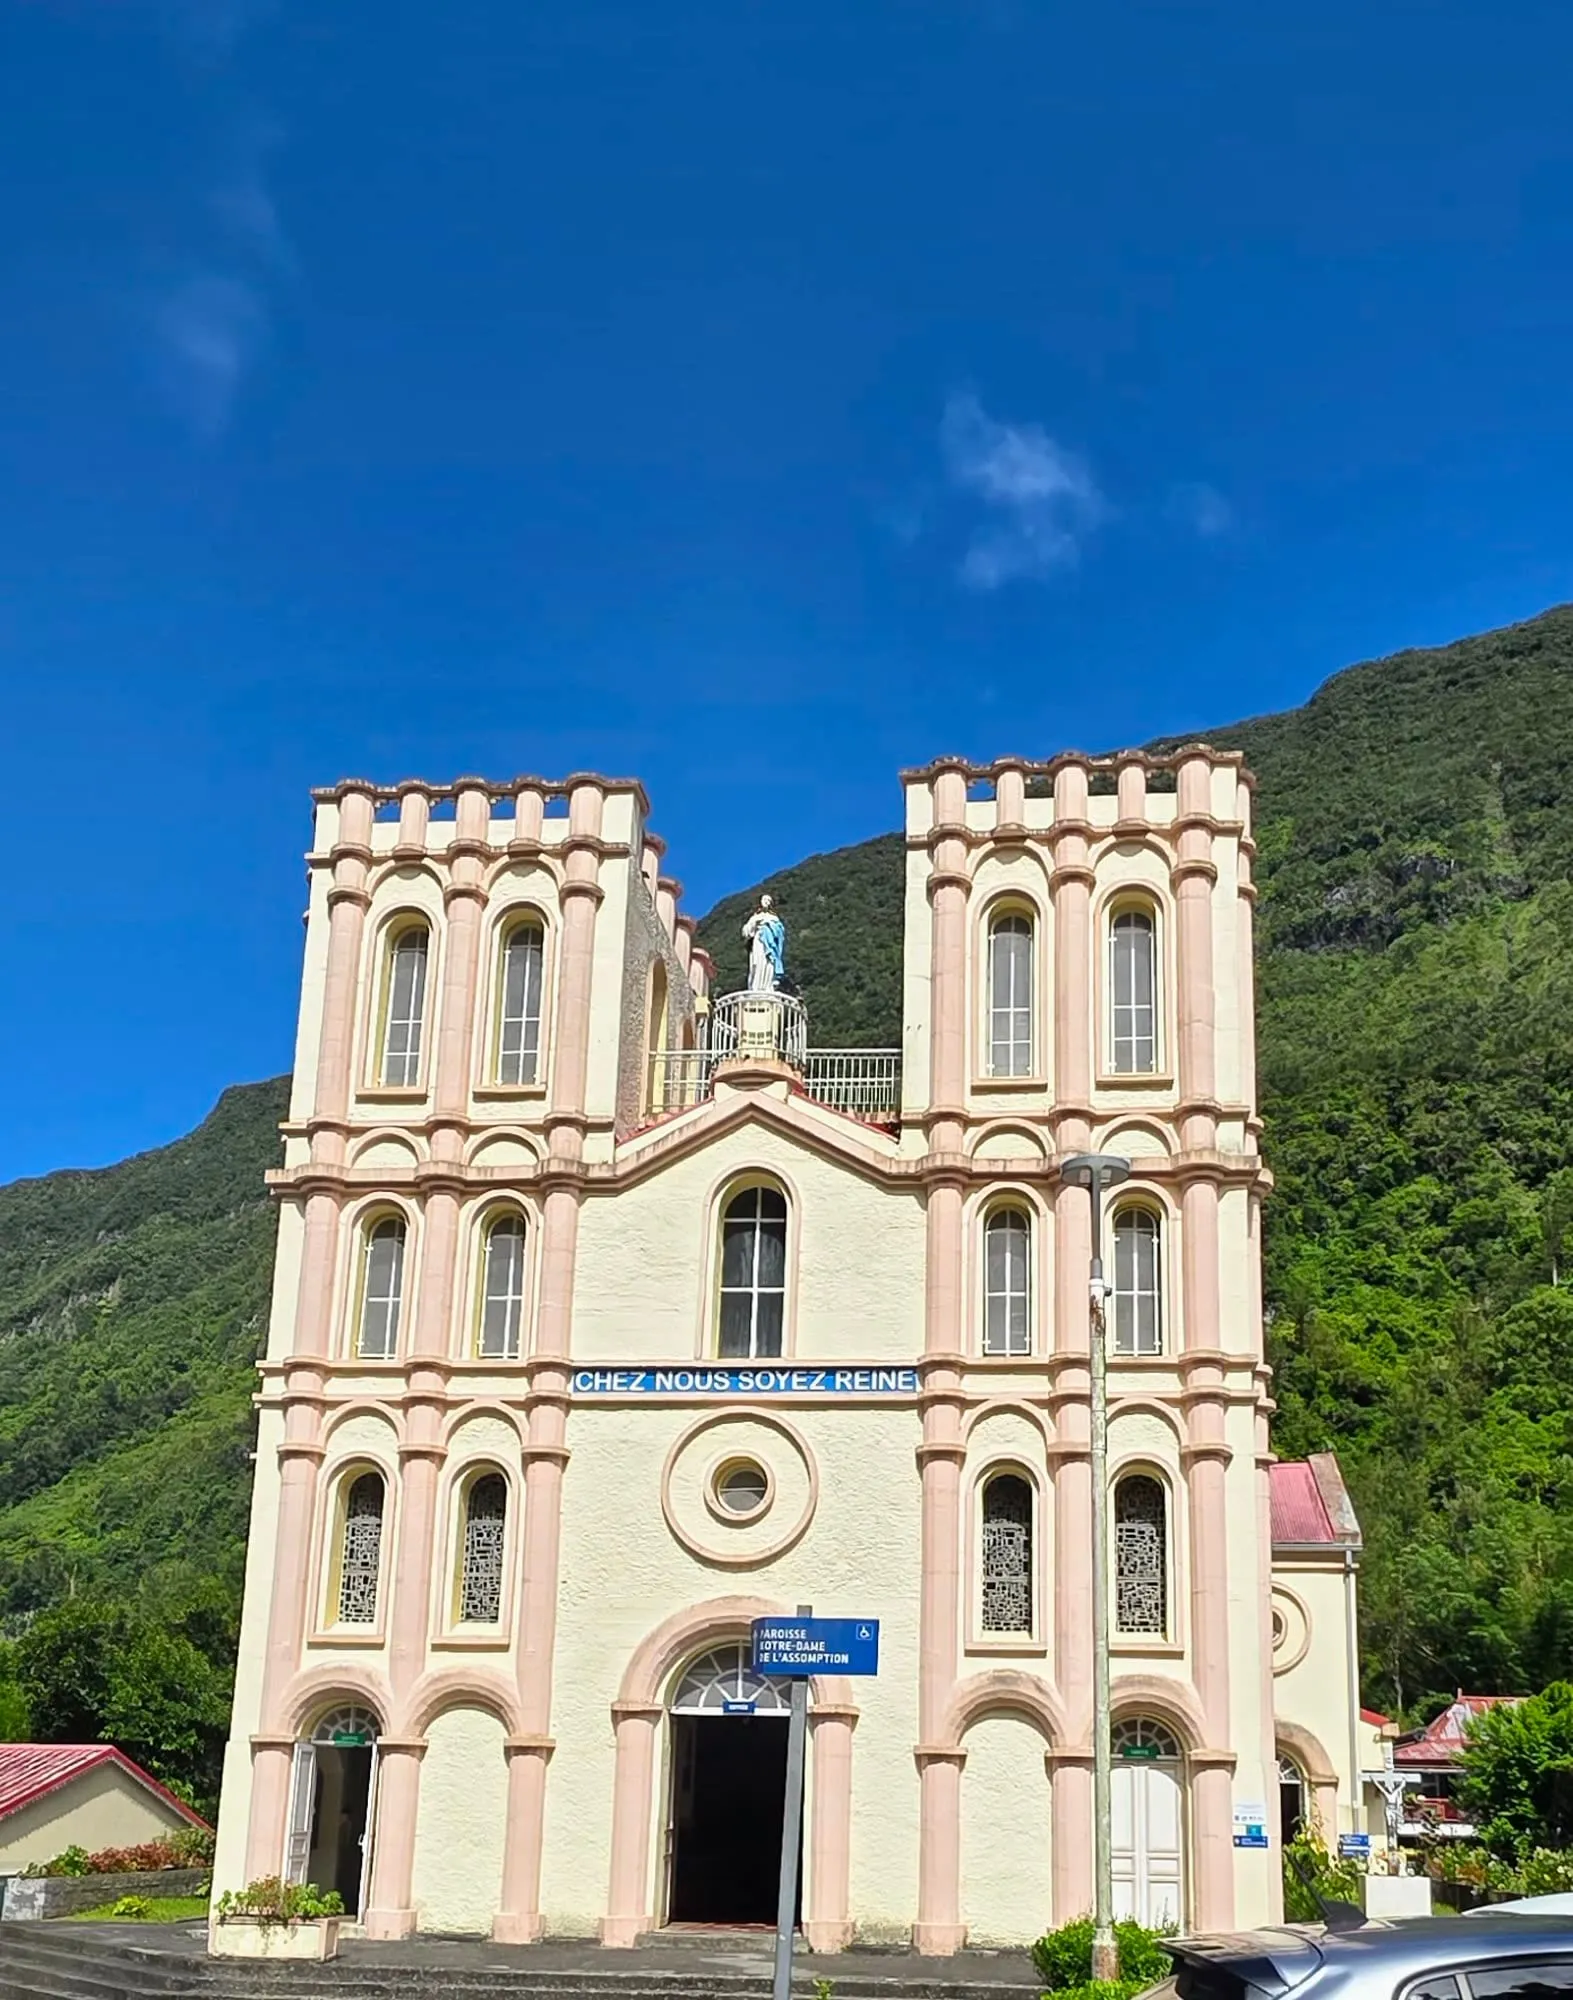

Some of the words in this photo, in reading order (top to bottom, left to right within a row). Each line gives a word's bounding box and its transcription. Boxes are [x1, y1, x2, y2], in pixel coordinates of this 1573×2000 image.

[575, 1372, 645, 1391] CHEZ
[656, 1371, 730, 1391] NOUS
[737, 1370, 827, 1391] SOYEZ
[836, 1370, 913, 1390] REINE
[772, 1653, 849, 1664] L'ASSOMPTION
